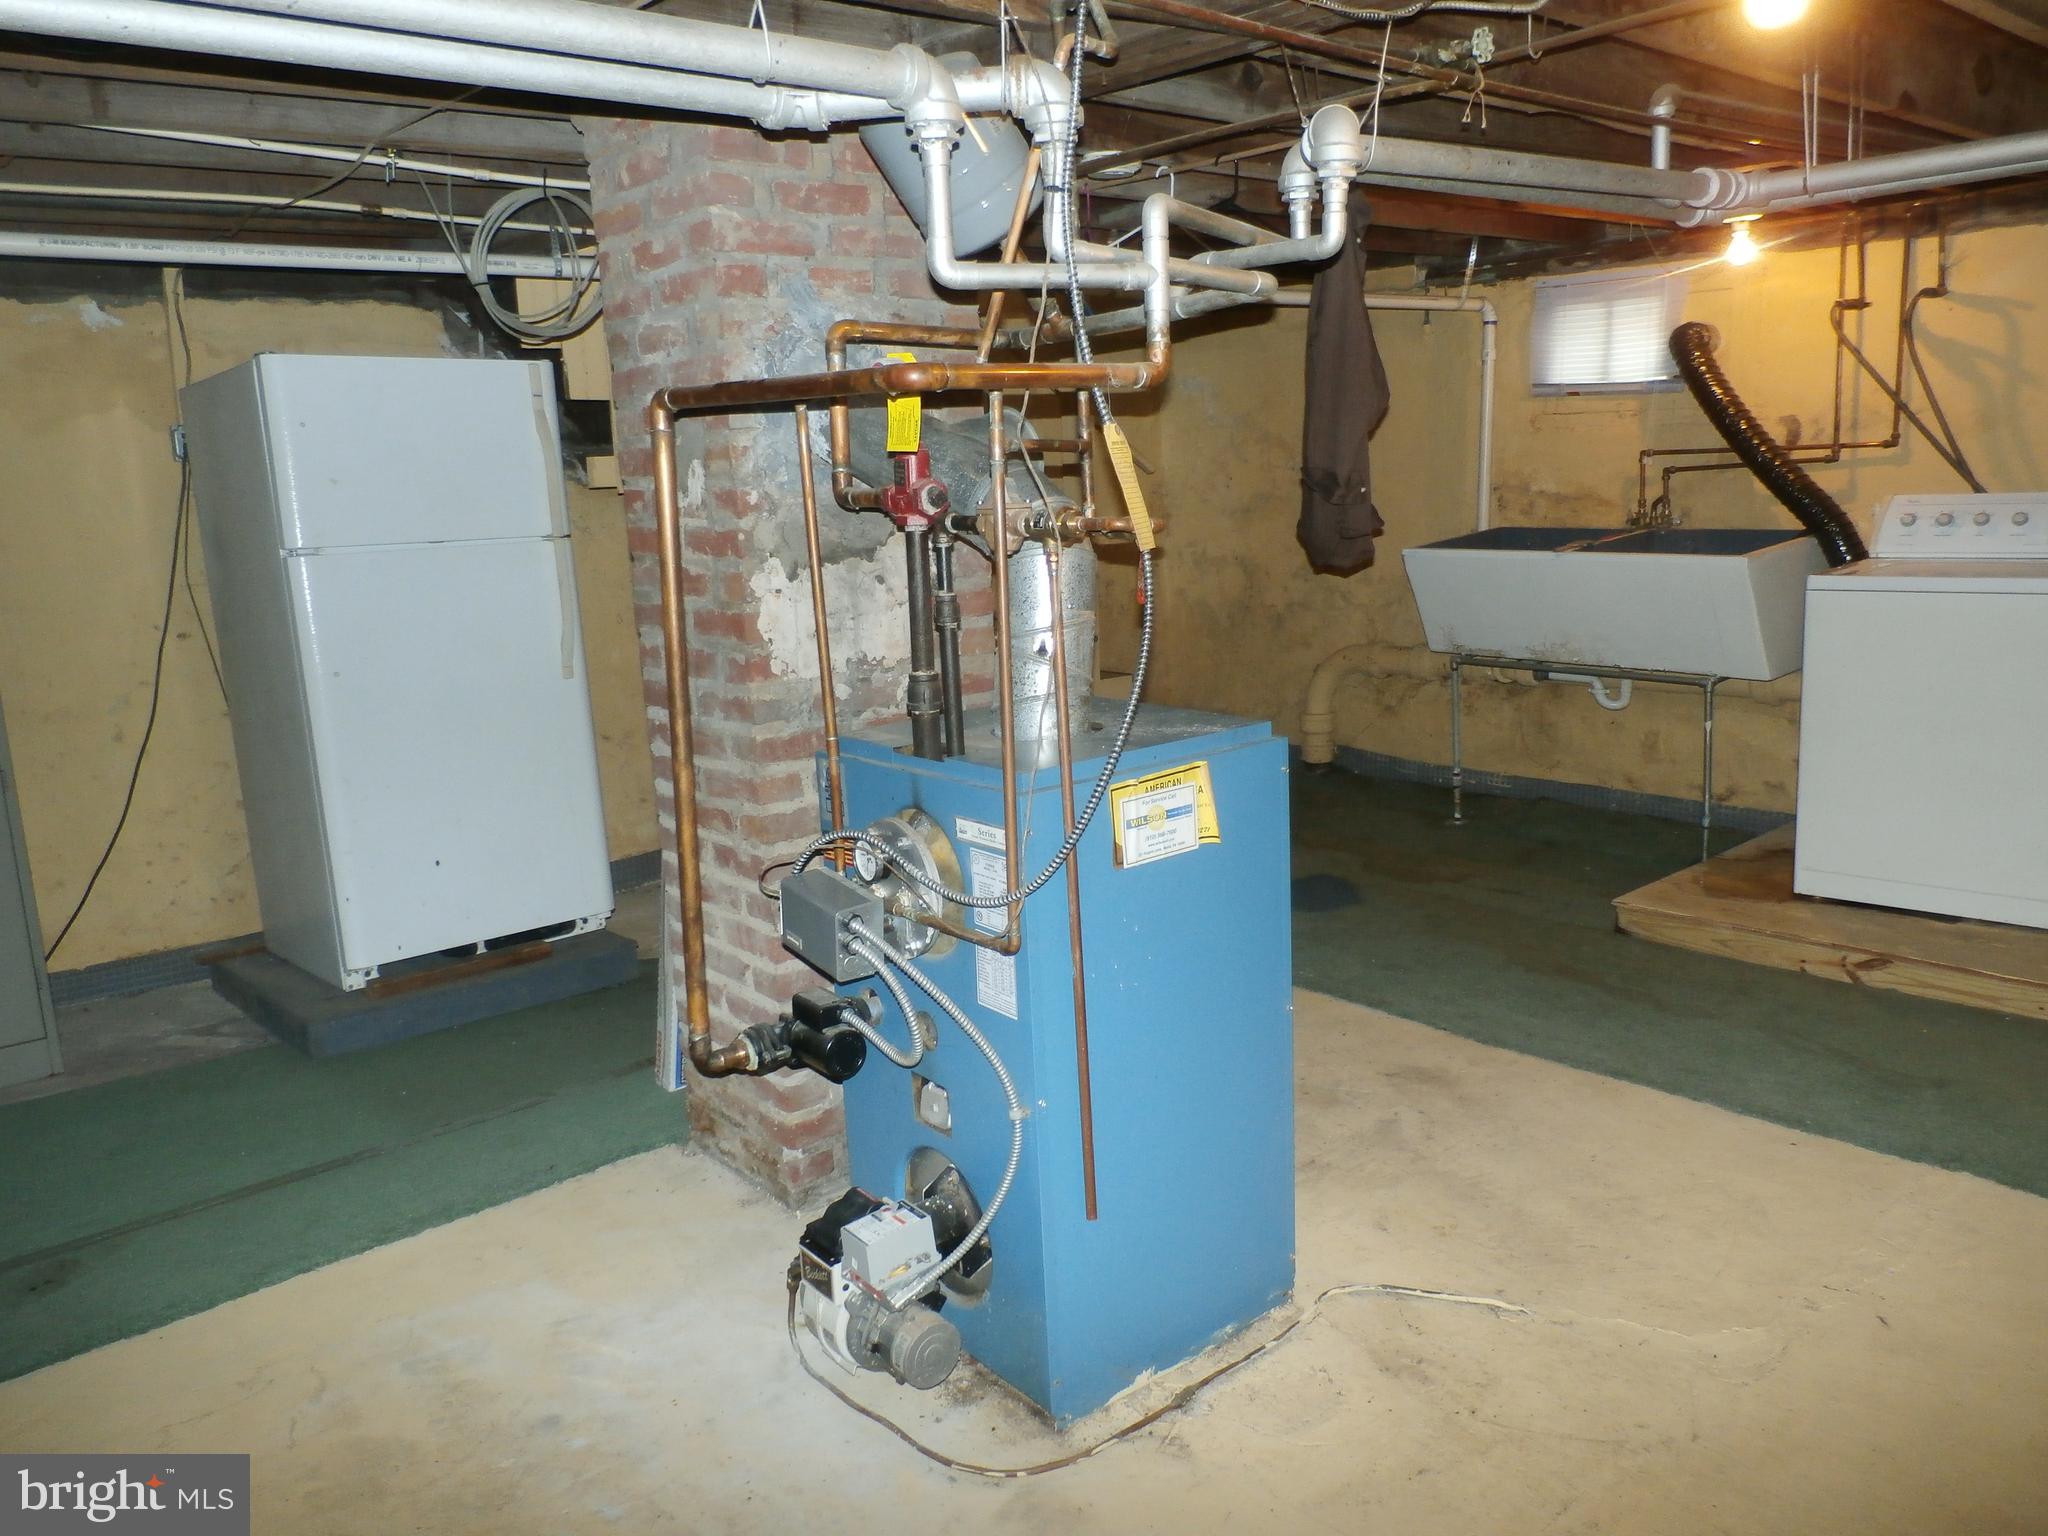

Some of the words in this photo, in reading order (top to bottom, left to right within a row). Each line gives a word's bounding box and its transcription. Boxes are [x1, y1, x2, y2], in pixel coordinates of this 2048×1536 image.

[1144, 778, 1182, 793] AMERICAN
[1130, 809, 1168, 828] WILSON
[977, 827, 997, 839] Series
